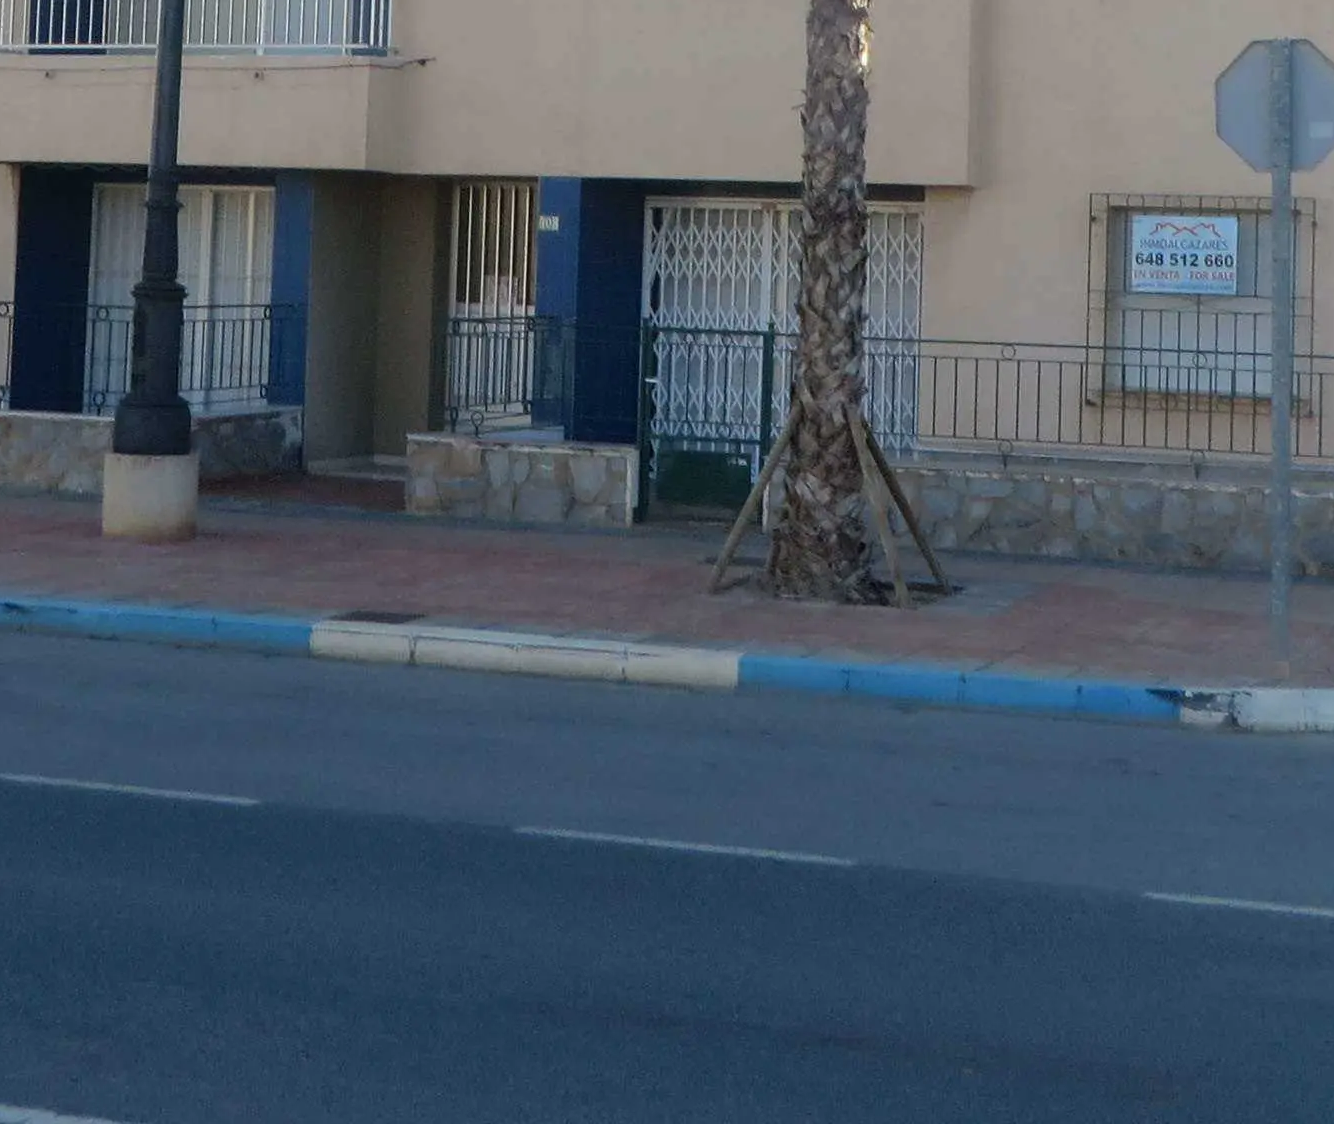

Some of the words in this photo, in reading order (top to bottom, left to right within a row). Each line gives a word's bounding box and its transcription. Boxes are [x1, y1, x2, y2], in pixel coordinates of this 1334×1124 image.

[1135, 253, 1164, 266] 648
[1169, 254, 1199, 267] 512
[1204, 254, 1234, 268] 660
[1149, 270, 1180, 280] VENTA
[1190, 270, 1209, 281] FOR
[1211, 271, 1235, 281] SALE
